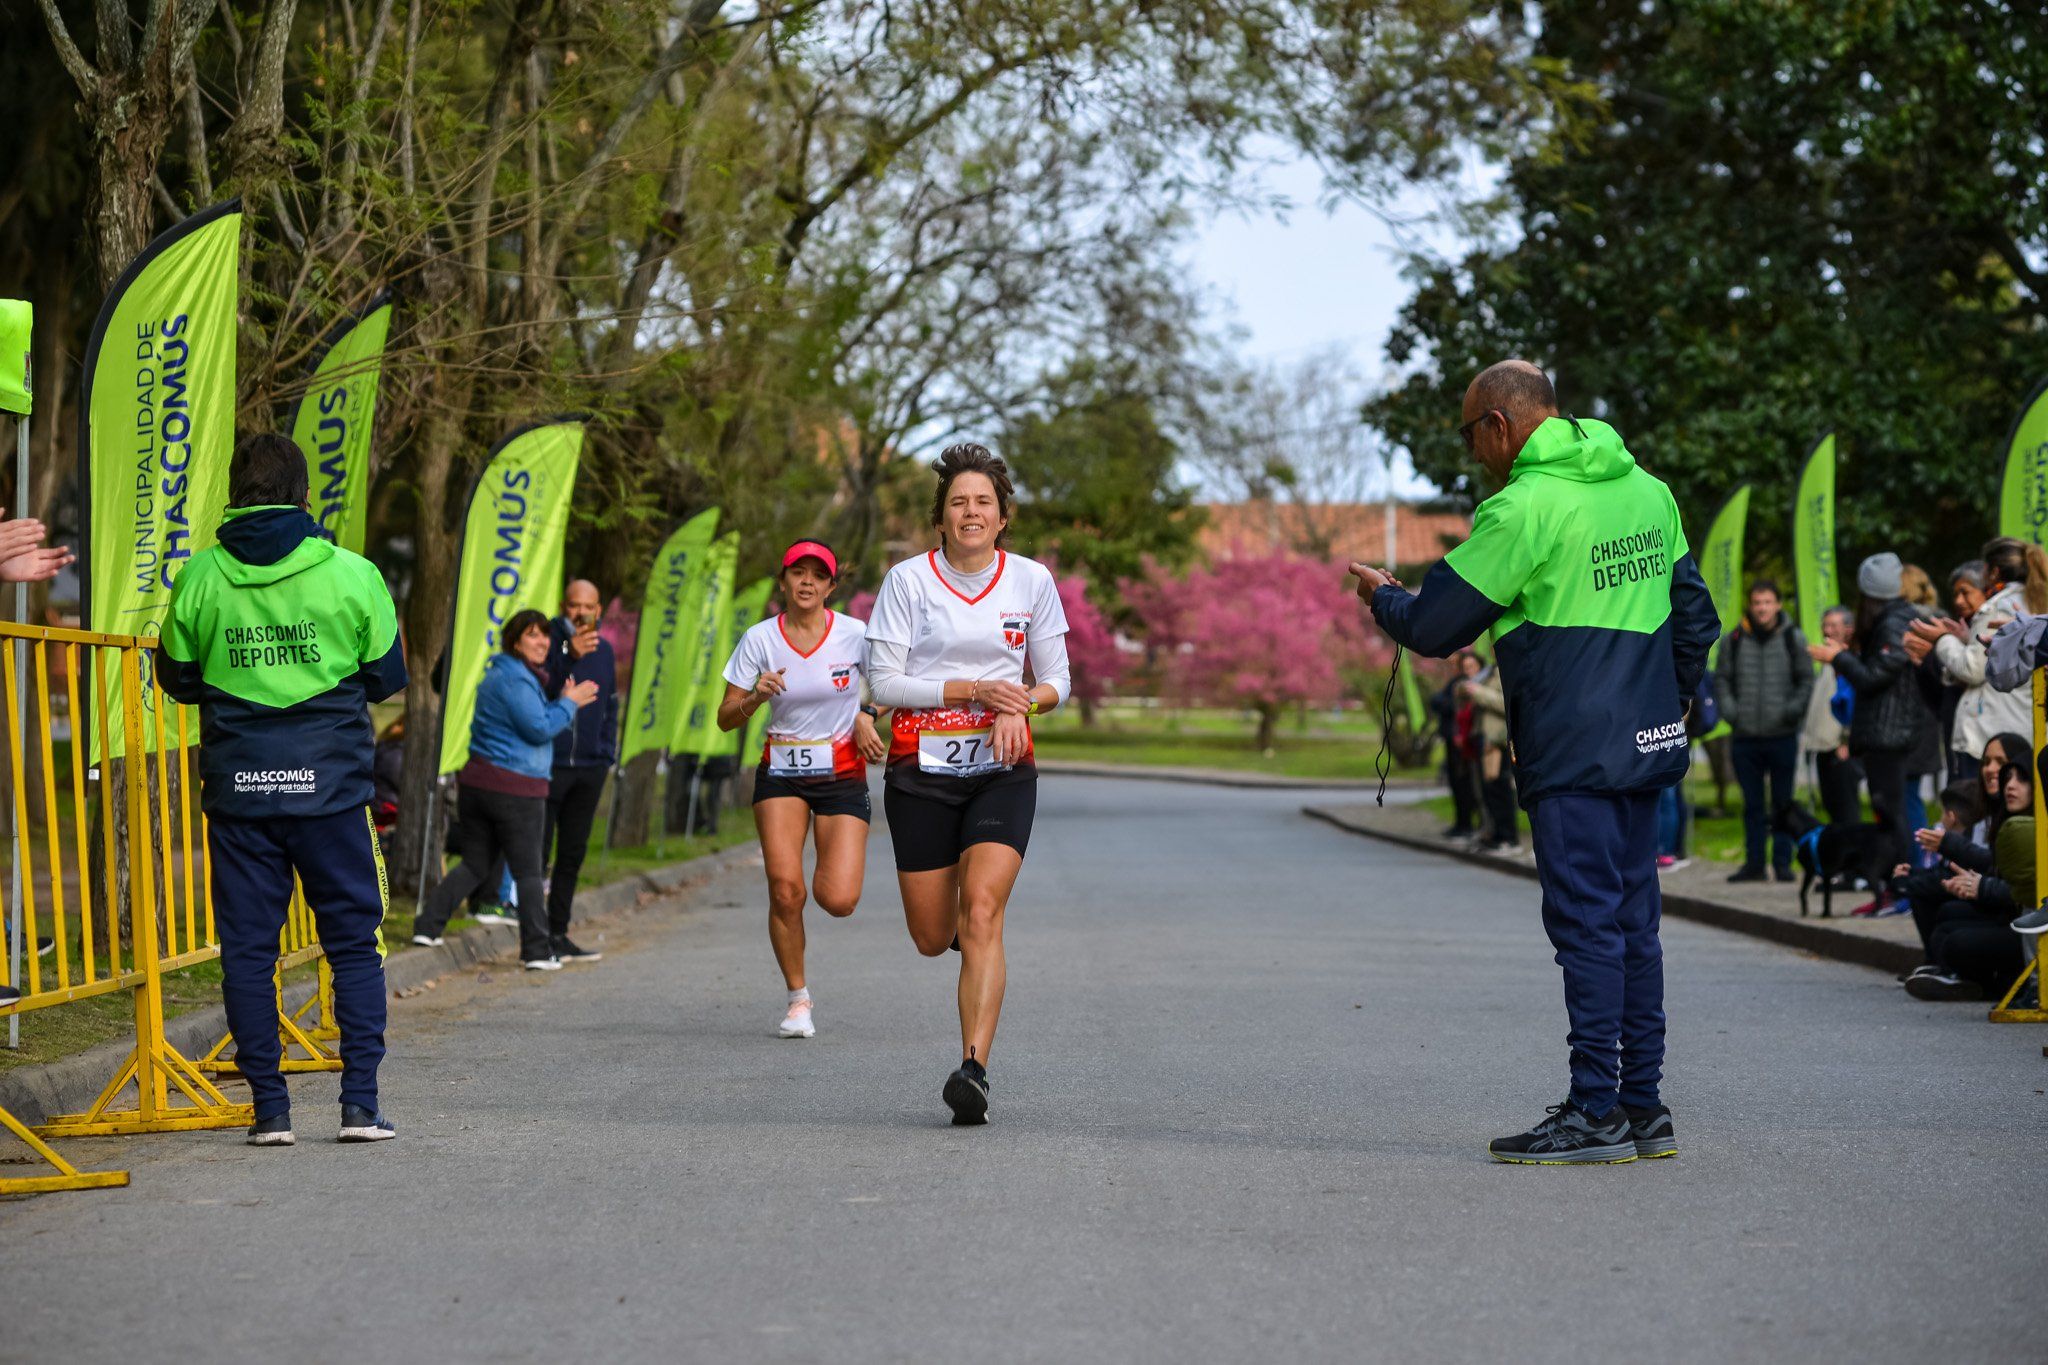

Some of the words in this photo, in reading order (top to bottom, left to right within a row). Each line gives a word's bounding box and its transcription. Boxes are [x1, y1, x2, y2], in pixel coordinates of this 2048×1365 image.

[137, 321, 155, 360] DE
[157, 313, 191, 590] CHASCOMÚS
[135, 368, 157, 593] MUNICIPALIDAD
[487, 470, 531, 648] COMÚS
[1591, 525, 1664, 564] CHASCOMÚS
[1593, 552, 1667, 592] DEPORTES
[224, 619, 317, 645] CHASCOMÚS
[228, 643, 322, 668] DEPORTES
[786, 748, 813, 768] 15
[945, 738, 982, 764] 27
[234, 767, 315, 783] CHASCOMÚS
[234, 783, 256, 792] Mucho
[257, 782, 278, 795] mejor
[278, 783, 292, 793] para
